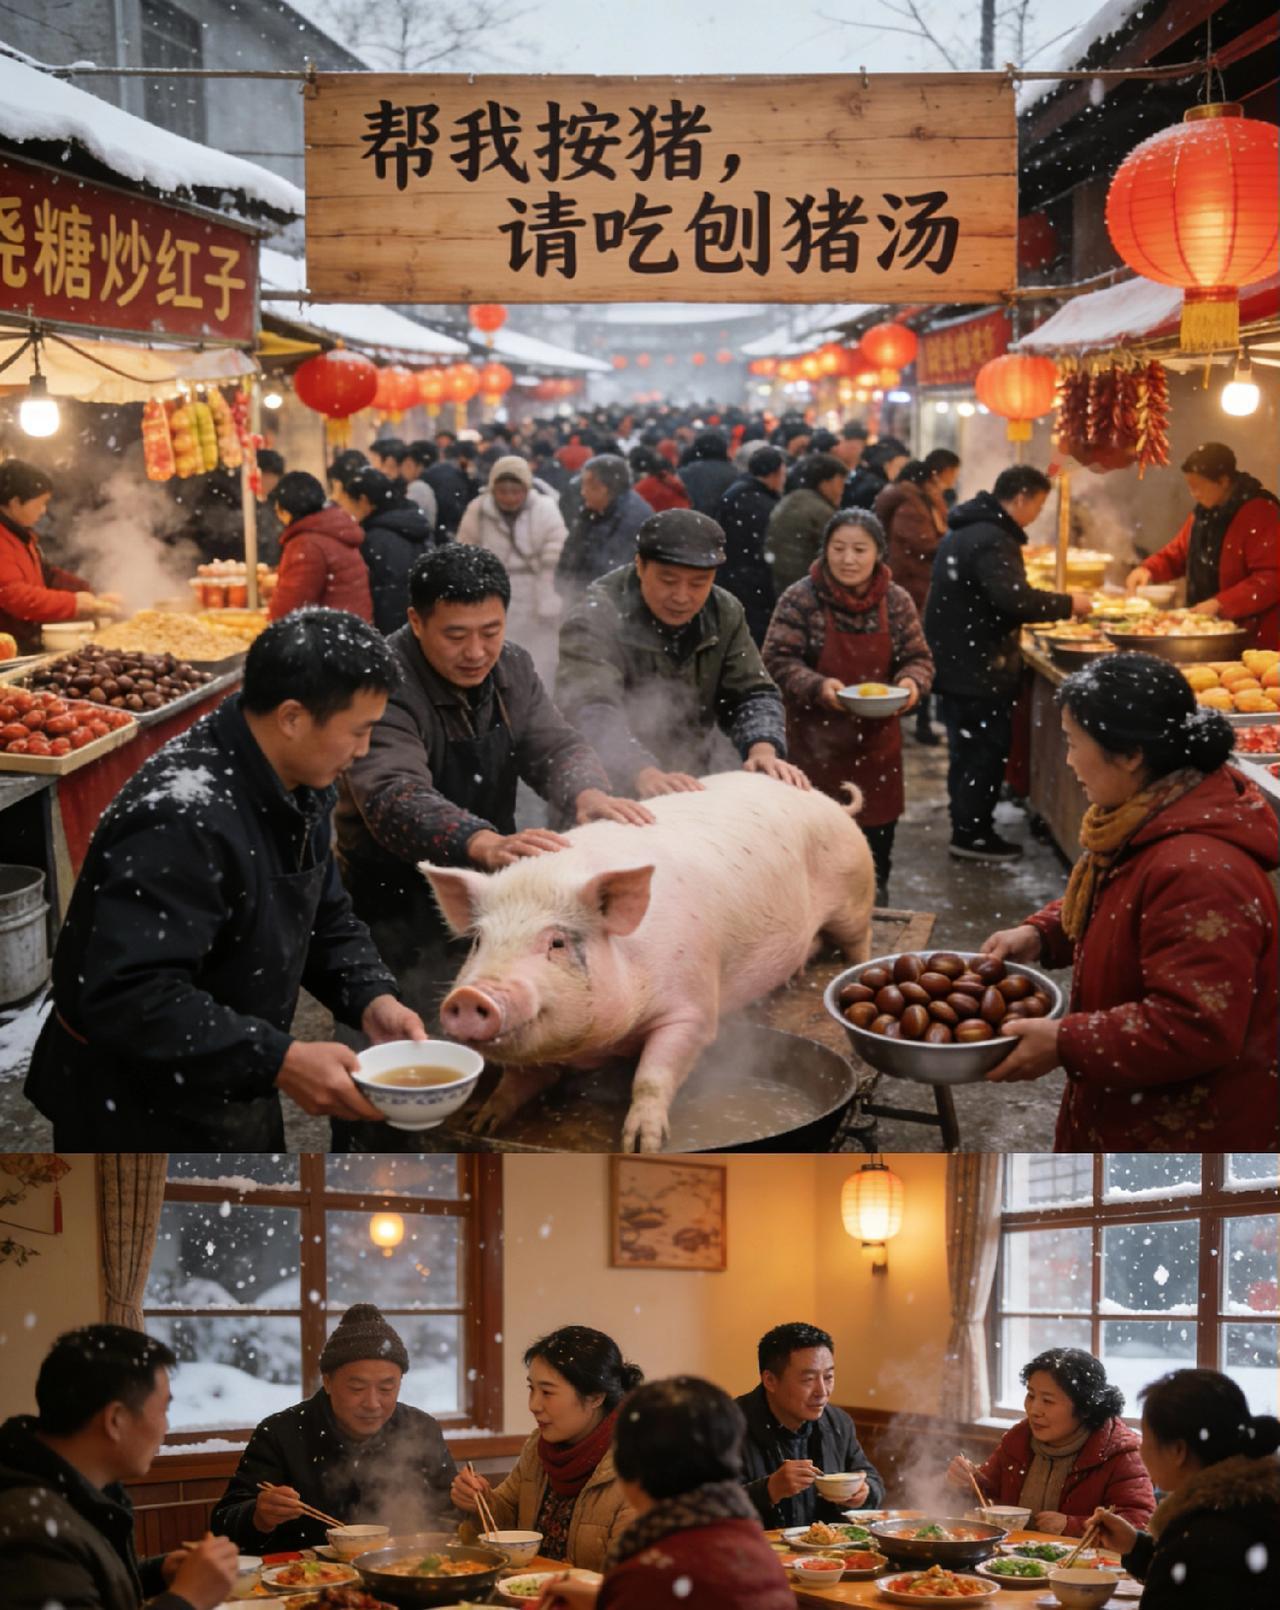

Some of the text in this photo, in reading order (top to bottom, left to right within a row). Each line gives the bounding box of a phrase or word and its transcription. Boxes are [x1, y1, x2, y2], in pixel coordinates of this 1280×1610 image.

[361, 99, 741, 191] 帮我按猪，
[498, 189, 961, 277] 请吃刨猪汤
